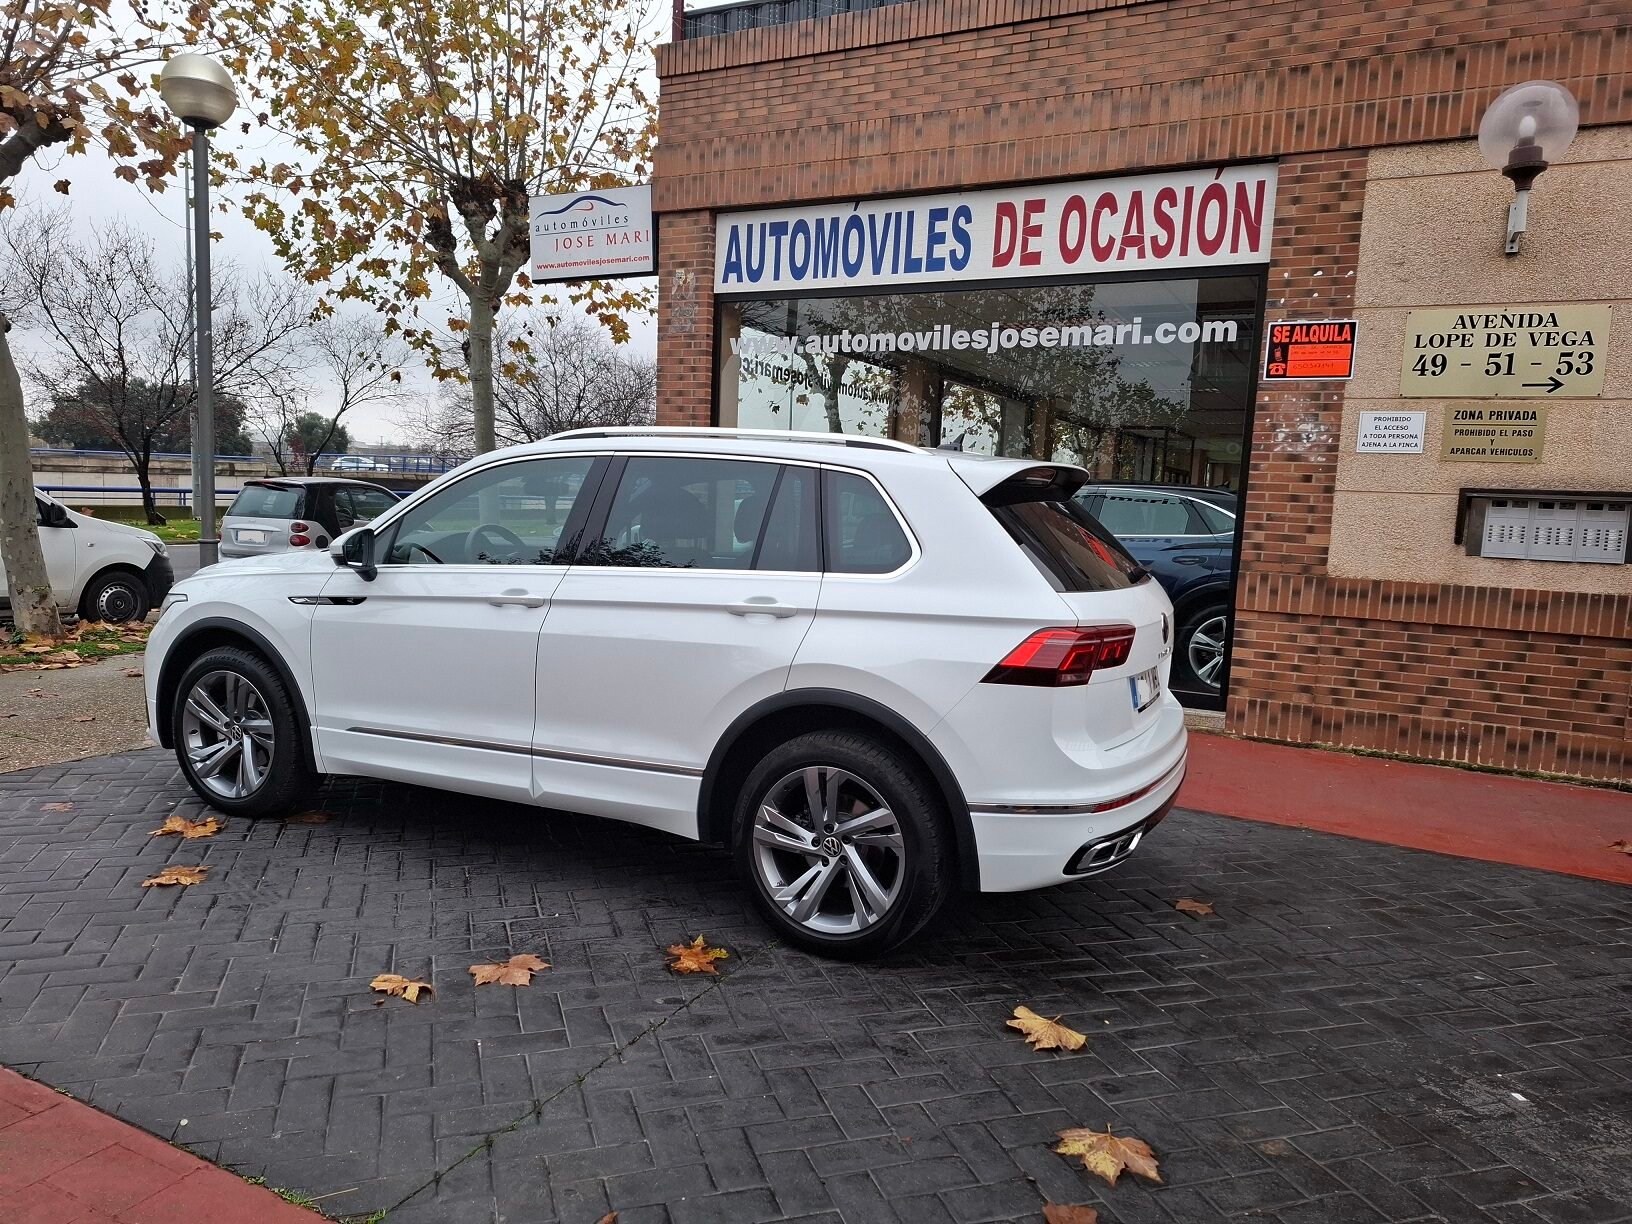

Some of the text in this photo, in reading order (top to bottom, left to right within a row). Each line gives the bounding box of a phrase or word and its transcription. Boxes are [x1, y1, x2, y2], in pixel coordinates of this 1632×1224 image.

[535, 214, 629, 233] automóviles
[722, 167, 1267, 284] AUTOMÓVILES DE OCASIÓN
[555, 229, 650, 252] JOSE MARI
[536, 254, 650, 271] www.automovilesjosemari.com
[1452, 312, 1559, 330] AVENIDA
[729, 316, 1238, 356] www.automovilesjosemari.com
[1273, 324, 1352, 343] SE ALQUILA
[1414, 330, 1596, 349] LOPE DE VEGA
[1411, 353, 1448, 377] 49
[1484, 351, 1516, 376] 51
[1555, 351, 1595, 376] 53
[1454, 410, 1537, 421] ZONA PRIVADA
[1454, 429, 1497, 437] PROHIBIDO
[1499, 429, 1509, 437] EL
[1489, 438, 1495, 446] Y
[1450, 447, 1534, 457] APARCAR VEHICULOS
